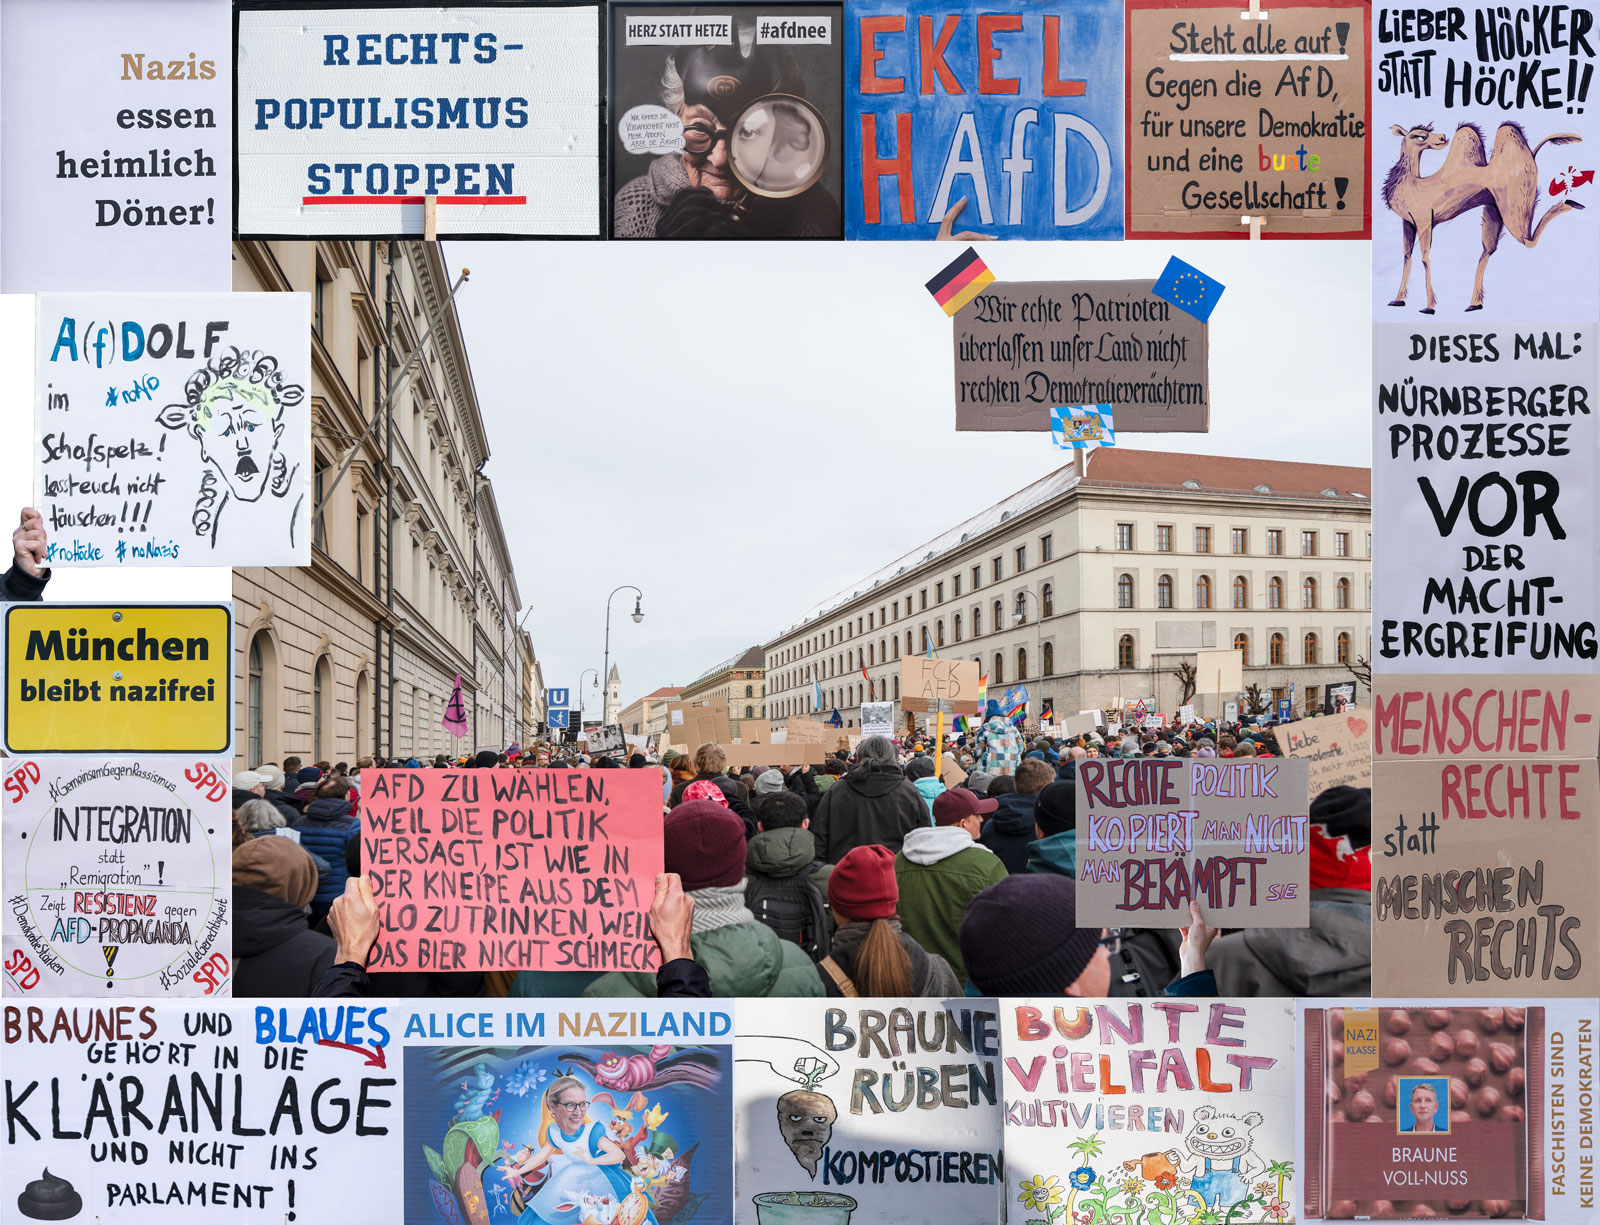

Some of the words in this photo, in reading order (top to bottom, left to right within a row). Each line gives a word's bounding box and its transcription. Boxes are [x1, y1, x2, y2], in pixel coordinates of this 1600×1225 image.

[629, 24, 657, 38] HERZ
[659, 24, 693, 38] STATT
[695, 24, 728, 38] HETZE
[761, 21, 826, 39] #afdnee
[1170, 22, 1233, 55] Steht
[1242, 24, 1286, 54] alle
[1294, 22, 1350, 55] auf!
[1475, 5, 1596, 62] HÖCKER
[323, 33, 524, 65] RECHTS-
[860, 15, 1087, 96] EKEL
[121, 53, 216, 82] Nazis
[1378, 49, 1437, 99] STATT
[1444, 58, 1594, 114] HÖCKE!!
[1145, 67, 1218, 109] Gegen
[1226, 67, 1262, 97] die
[1275, 66, 1339, 102] AfD,
[116, 107, 216, 129] essen
[254, 97, 528, 130] POPULISMUS
[1141, 110, 1175, 139] für
[1180, 119, 1246, 139] unsere
[1259, 108, 1366, 139] Demokratie
[56, 150, 216, 179] heimlich
[1147, 145, 1190, 173] und
[1199, 145, 1243, 173] eine
[1258, 144, 1321, 173] bunte
[307, 163, 515, 196] STOPPEN
[96, 199, 214, 227] Döner!
[974, 294, 1017, 324] Wir
[1022, 298, 1063, 331] echte
[1072, 292, 1171, 332] Patrioten
[50, 316, 229, 369] A(f)DOLF
[1094, 331, 1143, 363] Land
[1146, 329, 1190, 369] nicht
[1408, 333, 1499, 363] DIESES
[1514, 331, 1582, 360] MAL:
[48, 383, 69, 411] im
[961, 374, 1020, 407] rechten
[1379, 376, 1591, 417] NÜRNBERGER
[1388, 423, 1572, 462] PROZESSE
[128, 472, 166, 495] nicht
[1417, 470, 1567, 540] VOR
[1462, 544, 1525, 572] DER
[1422, 576, 1563, 616] MACHT-
[25, 628, 209, 661] München
[1380, 620, 1598, 660] ERGREIFUNG
[921, 659, 961, 681] FCK
[21, 678, 101, 702] bleibt
[110, 678, 215, 702] nazifrei
[552, 690, 565, 705] U
[921, 679, 960, 699] AFD
[1375, 688, 1592, 755] MENSCHEN-
[1287, 730, 1320, 752] Liebe
[4, 761, 41, 804] SPD
[184, 761, 227, 803] SPD
[370, 773, 425, 803] AFD
[440, 774, 479, 804] ZU
[491, 770, 610, 806] WÄHLEN,
[1079, 759, 1183, 809] RECHTE
[1191, 763, 1278, 798] POLITIK
[1441, 764, 1581, 820] RECHTE
[53, 805, 191, 845] INTEGRATION
[366, 806, 431, 835] WEIL
[442, 807, 483, 835] DIE
[492, 808, 609, 842] POLITIK
[1088, 810, 1199, 854] KOPIERT
[1202, 820, 1241, 841] MAN
[1244, 813, 1308, 855] NICHT
[1383, 812, 1440, 856] statt
[98, 849, 125, 864] statt
[365, 837, 487, 875] VERSAGT,
[496, 842, 534, 871] IST
[544, 844, 591, 874] WIE
[604, 844, 629, 875] IN
[369, 869, 412, 899] DER
[424, 869, 511, 904] KNEIPE
[519, 877, 573, 906] AUS
[583, 877, 639, 908] DEM
[1081, 859, 1121, 883] MAN
[1115, 852, 1267, 911] BEKÄMPFT
[1266, 883, 1298, 901] SIE
[1376, 860, 1544, 921] MENSCHEN
[40, 895, 67, 918] Zeigt
[73, 892, 157, 917] RESISTENZ
[164, 906, 197, 923] gegen
[599, 910, 655, 941] WEIL
[50, 917, 191, 945] AFD-PROPAGANDA
[1444, 904, 1582, 985] RECHTS
[4, 949, 41, 990] SPD
[367, 938, 408, 968] DAS
[418, 939, 466, 970] BIER
[479, 939, 550, 969] NICHT
[193, 952, 230, 995] SPD
[4, 1006, 157, 1044] BRAUNES
[184, 1012, 232, 1037] UND
[255, 1005, 391, 1048] BLAUES
[404, 1012, 494, 1038] ALICE
[506, 1012, 545, 1037] IM
[558, 1011, 732, 1037] NAZILAND
[824, 1007, 999, 1059] BRAUNE
[1015, 1002, 1247, 1047] BUNTE
[1346, 1029, 1377, 1041] NAZI
[87, 1040, 196, 1067] GEHÖRT
[214, 1046, 239, 1070] IN
[264, 1046, 309, 1071] DIE
[1346, 1046, 1377, 1055] KLASSE
[1551, 1031, 1564, 1081] SIND
[850, 1061, 998, 1115] RÜBEN
[1578, 1019, 1593, 1149] DEMOKRATEN
[5, 1071, 397, 1144] KLÄRANLAGE
[90, 1142, 148, 1165] UND
[169, 1140, 245, 1170] NICHT
[270, 1145, 318, 1170] INS
[1392, 1147, 1457, 1163] BRAUNE
[1551, 1084, 1566, 1196] FASCHISTEN
[1383, 1170, 1468, 1186] VOLL-NUSS
[1580, 1156, 1594, 1209] KEINE
